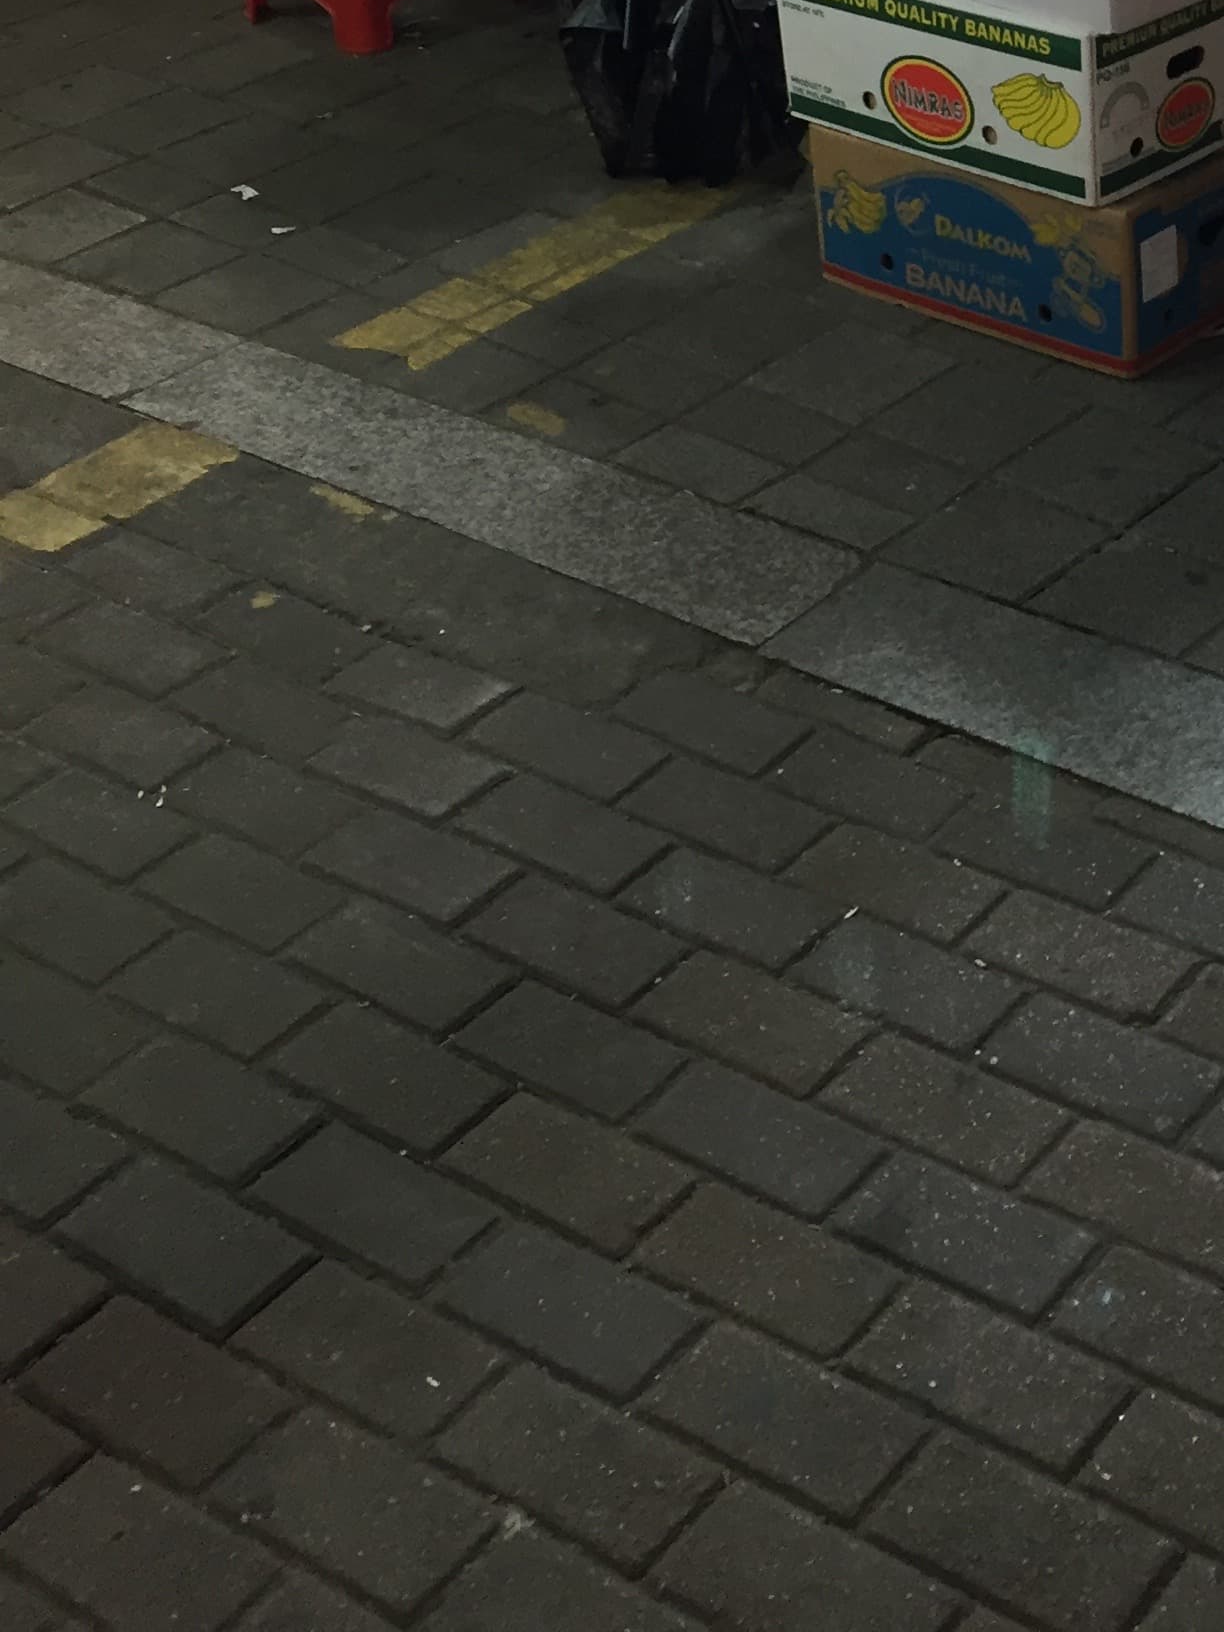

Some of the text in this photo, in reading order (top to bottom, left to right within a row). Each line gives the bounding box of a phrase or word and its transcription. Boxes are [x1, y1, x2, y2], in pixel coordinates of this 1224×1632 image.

[885, 0, 959, 33] QUALITY
[963, 19, 1052, 56] BANANAS
[892, 79, 964, 123] NIMRAS
[905, 262, 1029, 323] BANANA
